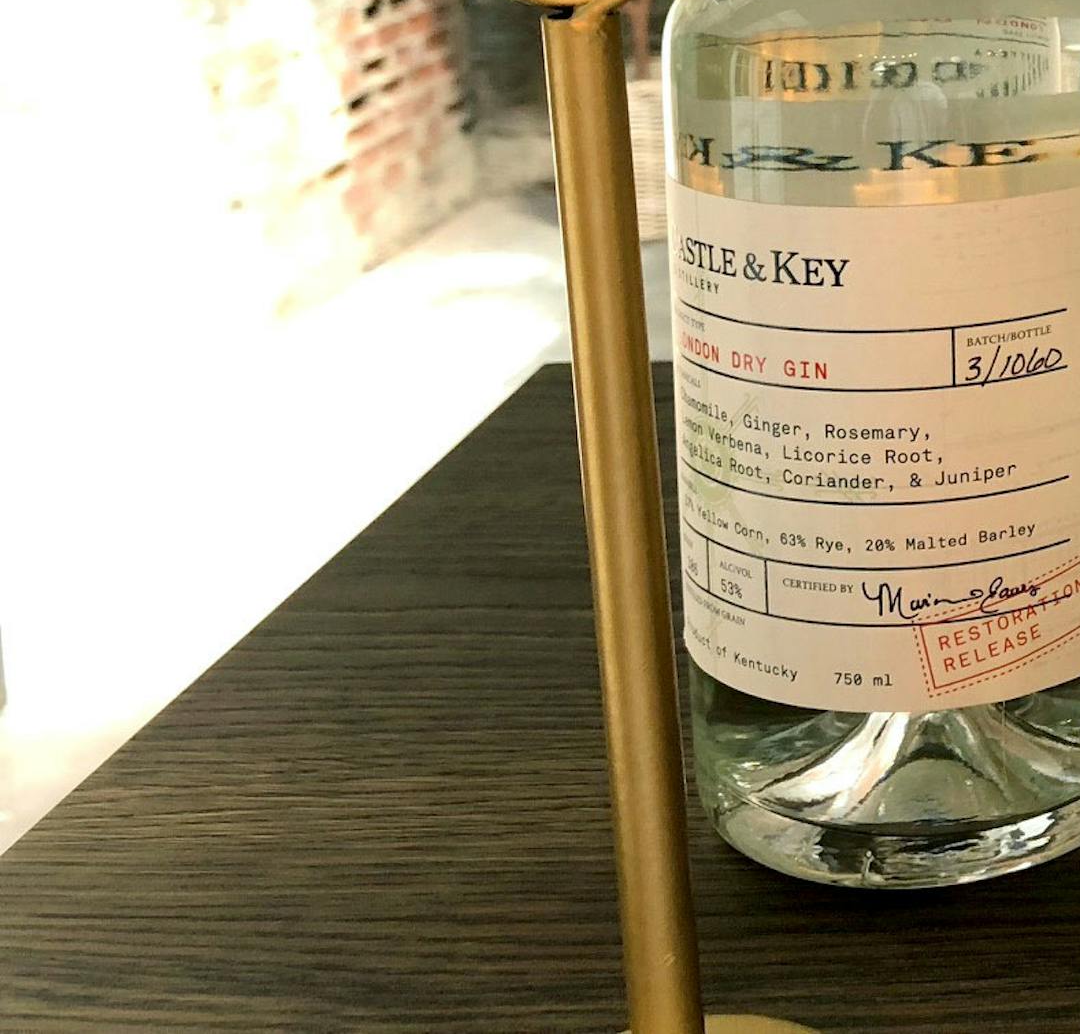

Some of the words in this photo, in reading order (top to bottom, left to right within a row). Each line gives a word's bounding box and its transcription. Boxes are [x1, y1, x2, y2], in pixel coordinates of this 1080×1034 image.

[743, 252, 767, 283] &
[770, 249, 850, 288] KEY
[966, 324, 1053, 347] BATCH/BOTTLE
[731, 350, 767, 374] DRY
[783, 359, 828, 380] GIN
[742, 413, 811, 441] Ginger,
[824, 423, 931, 443] Rosemary,
[708, 426, 770, 460] Verbena,
[783, 444, 872, 465] Licorice
[885, 448, 944, 467] Root,
[730, 457, 771, 485] Root,
[783, 469, 894, 492] Coriander,
[909, 472, 922, 488] &
[935, 463, 1017, 486] Juniper
[734, 521, 770, 545] Corn,
[779, 532, 807, 548] 63%
[815, 536, 852, 554] Rye,
[865, 539, 896, 552] 20%
[906, 533, 967, 551] Malted
[978, 523, 1036, 543] Barley
[720, 578, 743, 599] 53%
[782, 577, 837, 593] CERTIFIED
[840, 583, 854, 594] BY
[943, 623, 1042, 673] RELEASE
[716, 646, 727, 659] of
[734, 651, 799, 683] Kentucky
[833, 672, 863, 687] 750
[873, 674, 893, 687] ml
